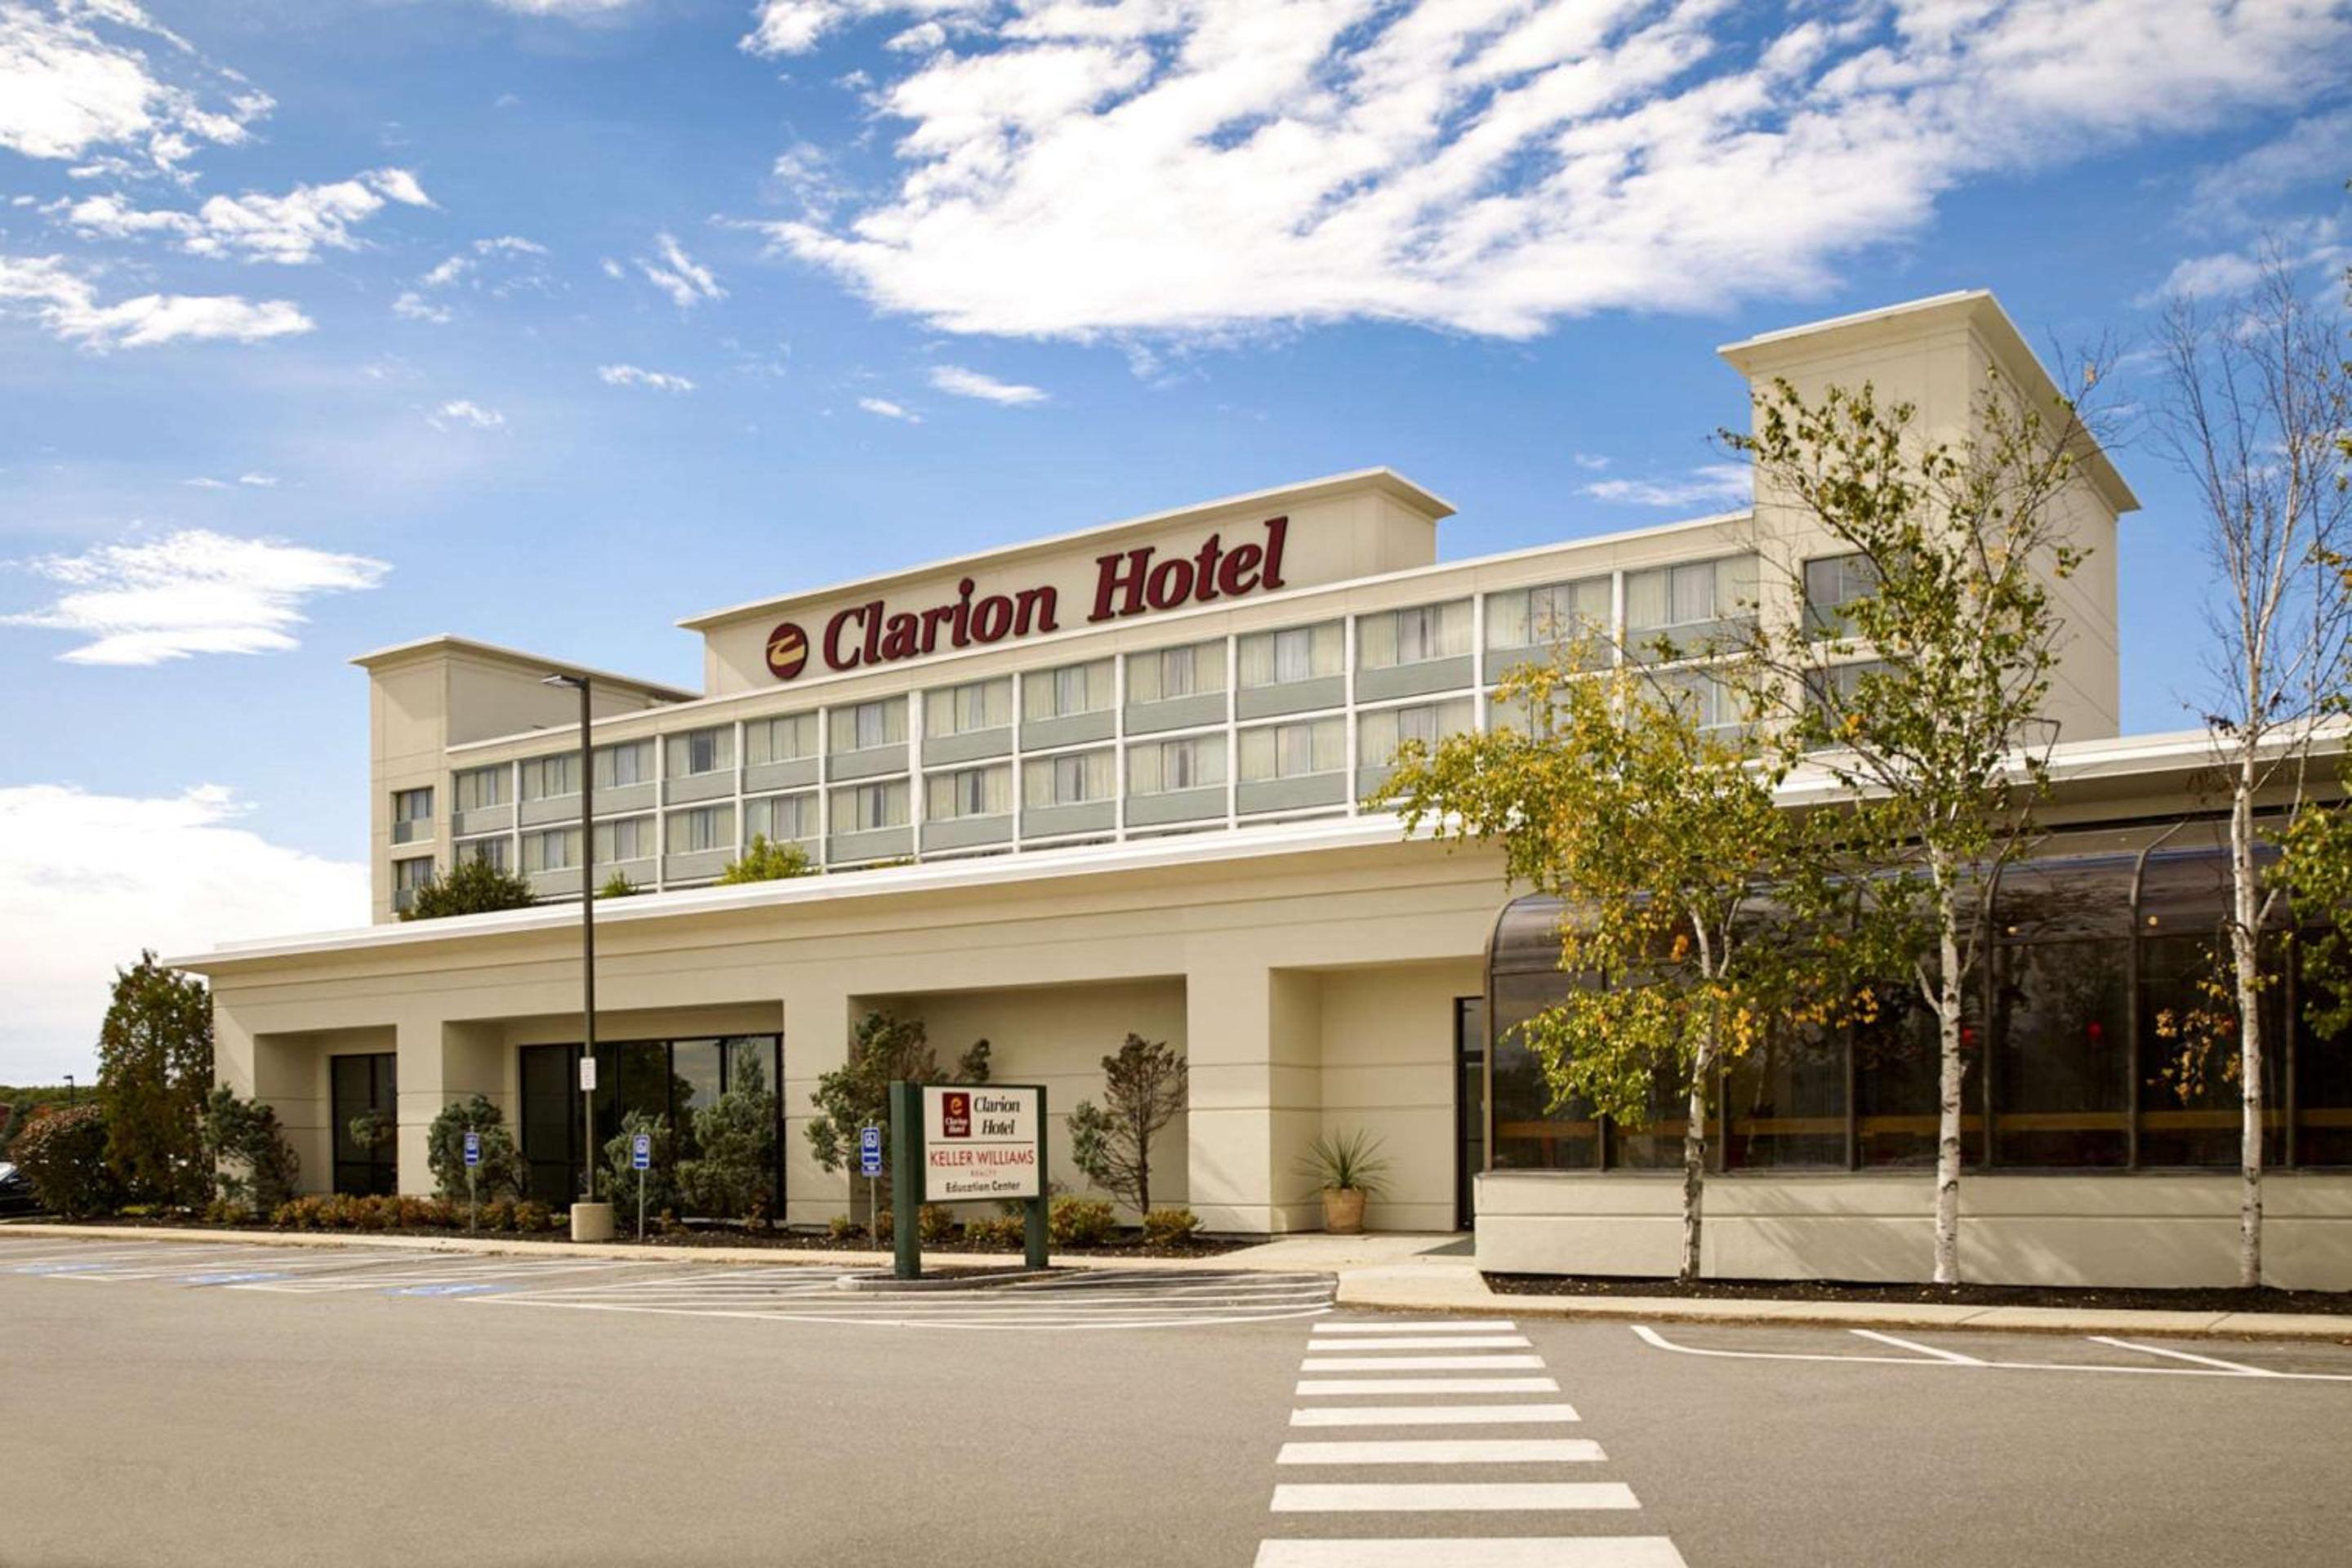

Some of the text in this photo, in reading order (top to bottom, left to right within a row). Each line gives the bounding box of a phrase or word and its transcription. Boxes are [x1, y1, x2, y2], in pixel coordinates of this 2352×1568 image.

[823, 516, 1288, 670] Clarion Hotel
[973, 1095, 1020, 1113] Clarion
[982, 1119, 1015, 1135] Hotel
[930, 1148, 1034, 1166] KELLER WILLIAMS
[946, 1180, 1020, 1192] Education Center
